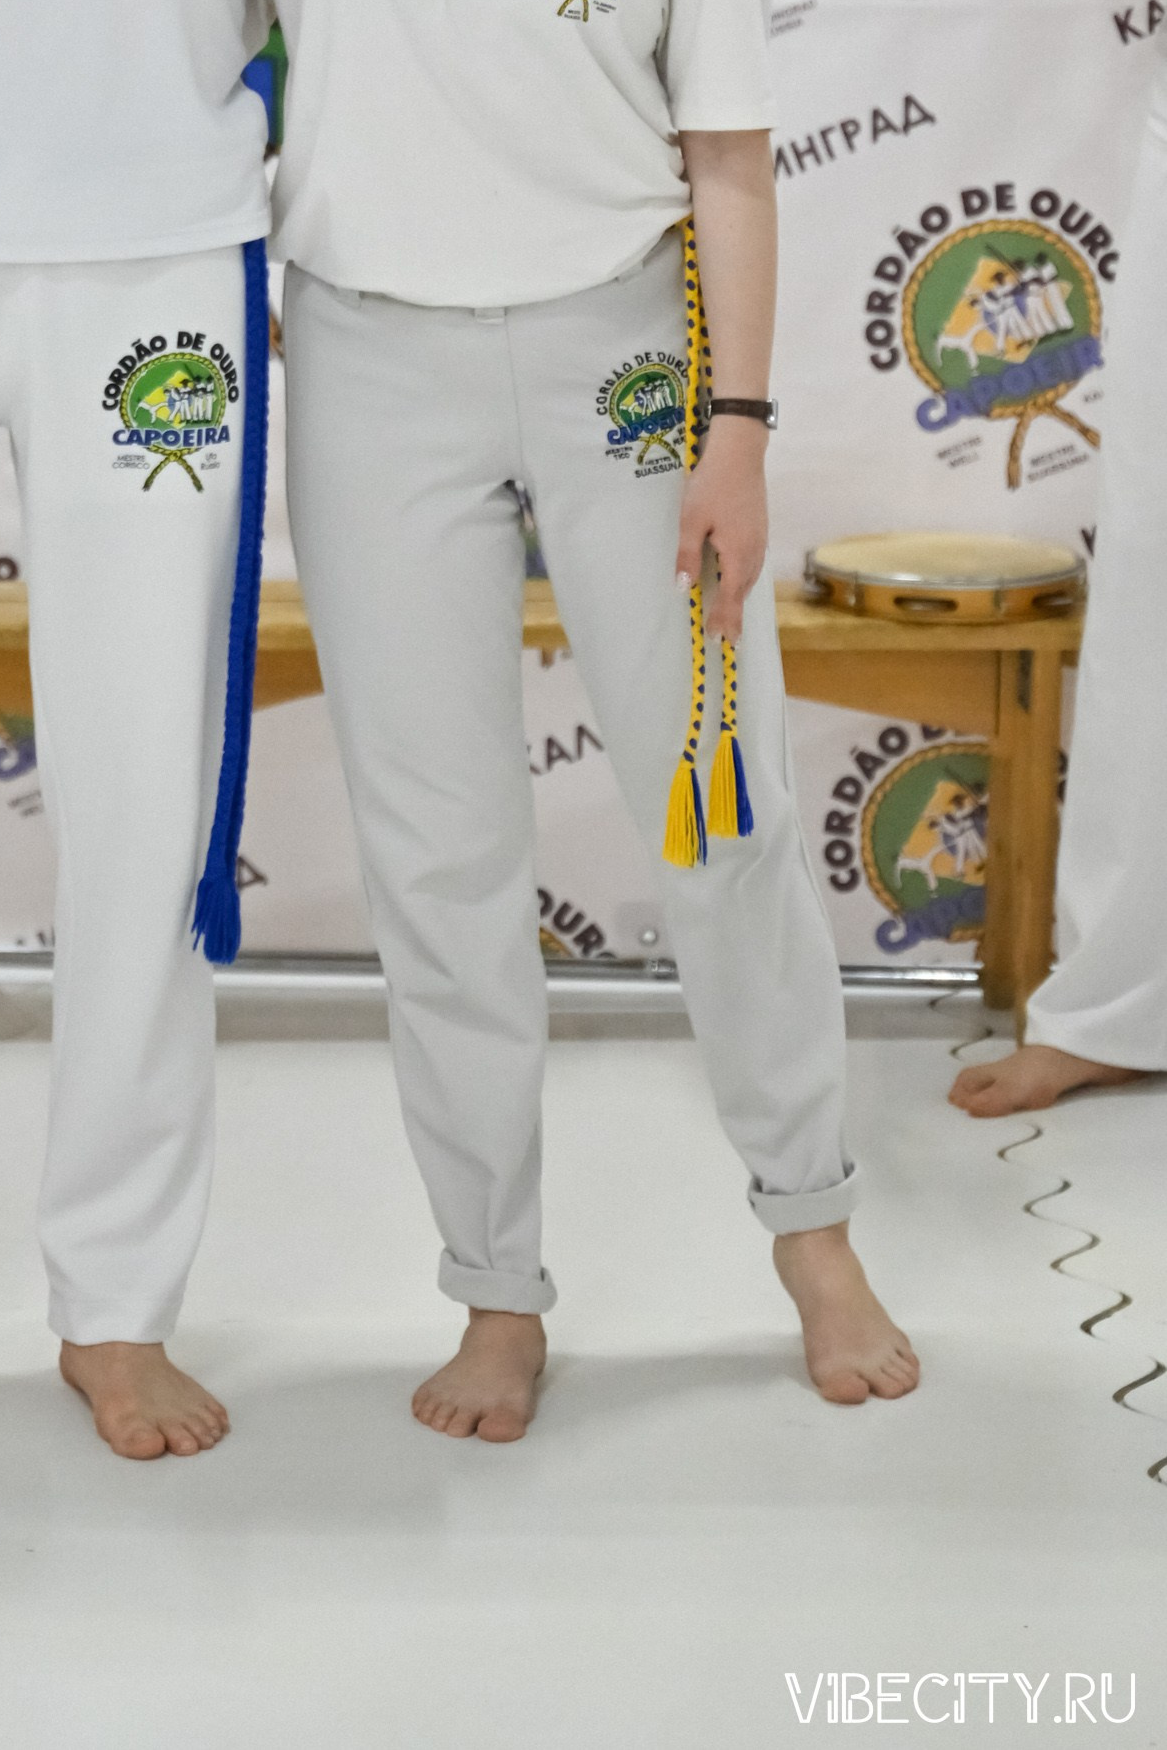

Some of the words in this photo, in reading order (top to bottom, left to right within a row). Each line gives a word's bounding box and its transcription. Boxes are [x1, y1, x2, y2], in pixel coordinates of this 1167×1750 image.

[863, 204, 951, 372] CORDÃO
[960, 183, 1016, 217] DE
[102, 335, 167, 412] CORDÃO
[177, 331, 207, 351] DE
[210, 343, 240, 404] OURO
[596, 362, 633, 416] CORDÃO
[634, 352, 654, 366] DE
[112, 425, 230, 447] CAPOEIRA
[823, 726, 910, 894] CORDÃO
